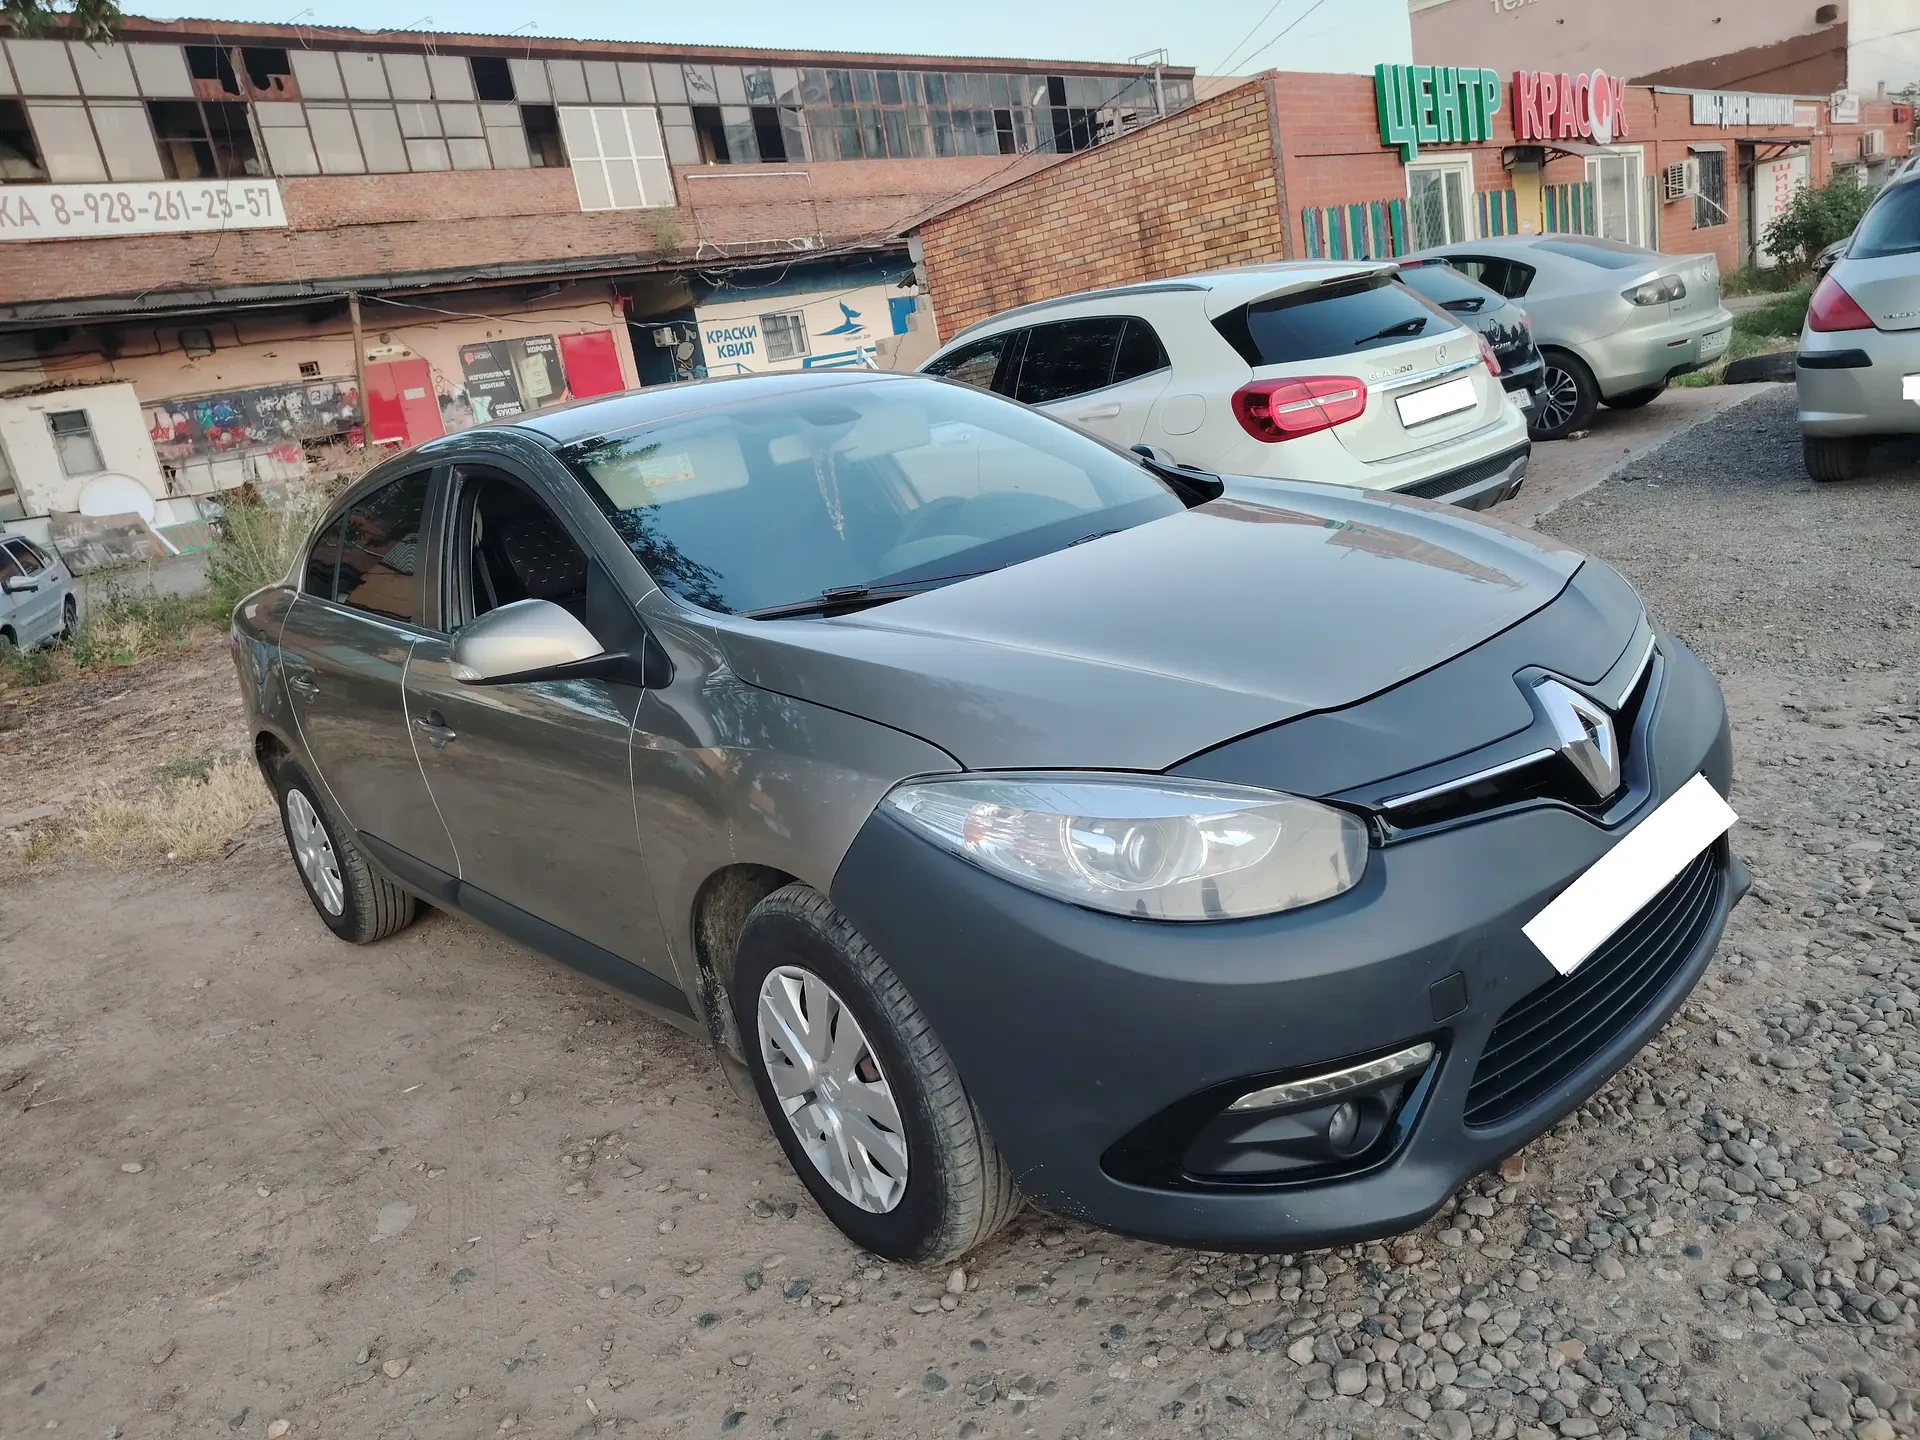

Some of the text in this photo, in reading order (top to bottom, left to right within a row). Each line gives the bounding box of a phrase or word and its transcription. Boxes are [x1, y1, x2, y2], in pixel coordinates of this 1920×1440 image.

[1374, 63, 1628, 162] ЦЕНТР КРАСОК
[50, 188, 271, 225] 8-928-261-25-57
[706, 325, 757, 344] КРАСКИ
[527, 345, 553, 353] КОРОБА
[717, 341, 755, 358] КВИЛ
[469, 370, 511, 380] ИЗГОТОВЛЕНИЕ
[480, 381, 505, 390] МОНТАЖ
[496, 407, 521, 417] БУКВЫ
